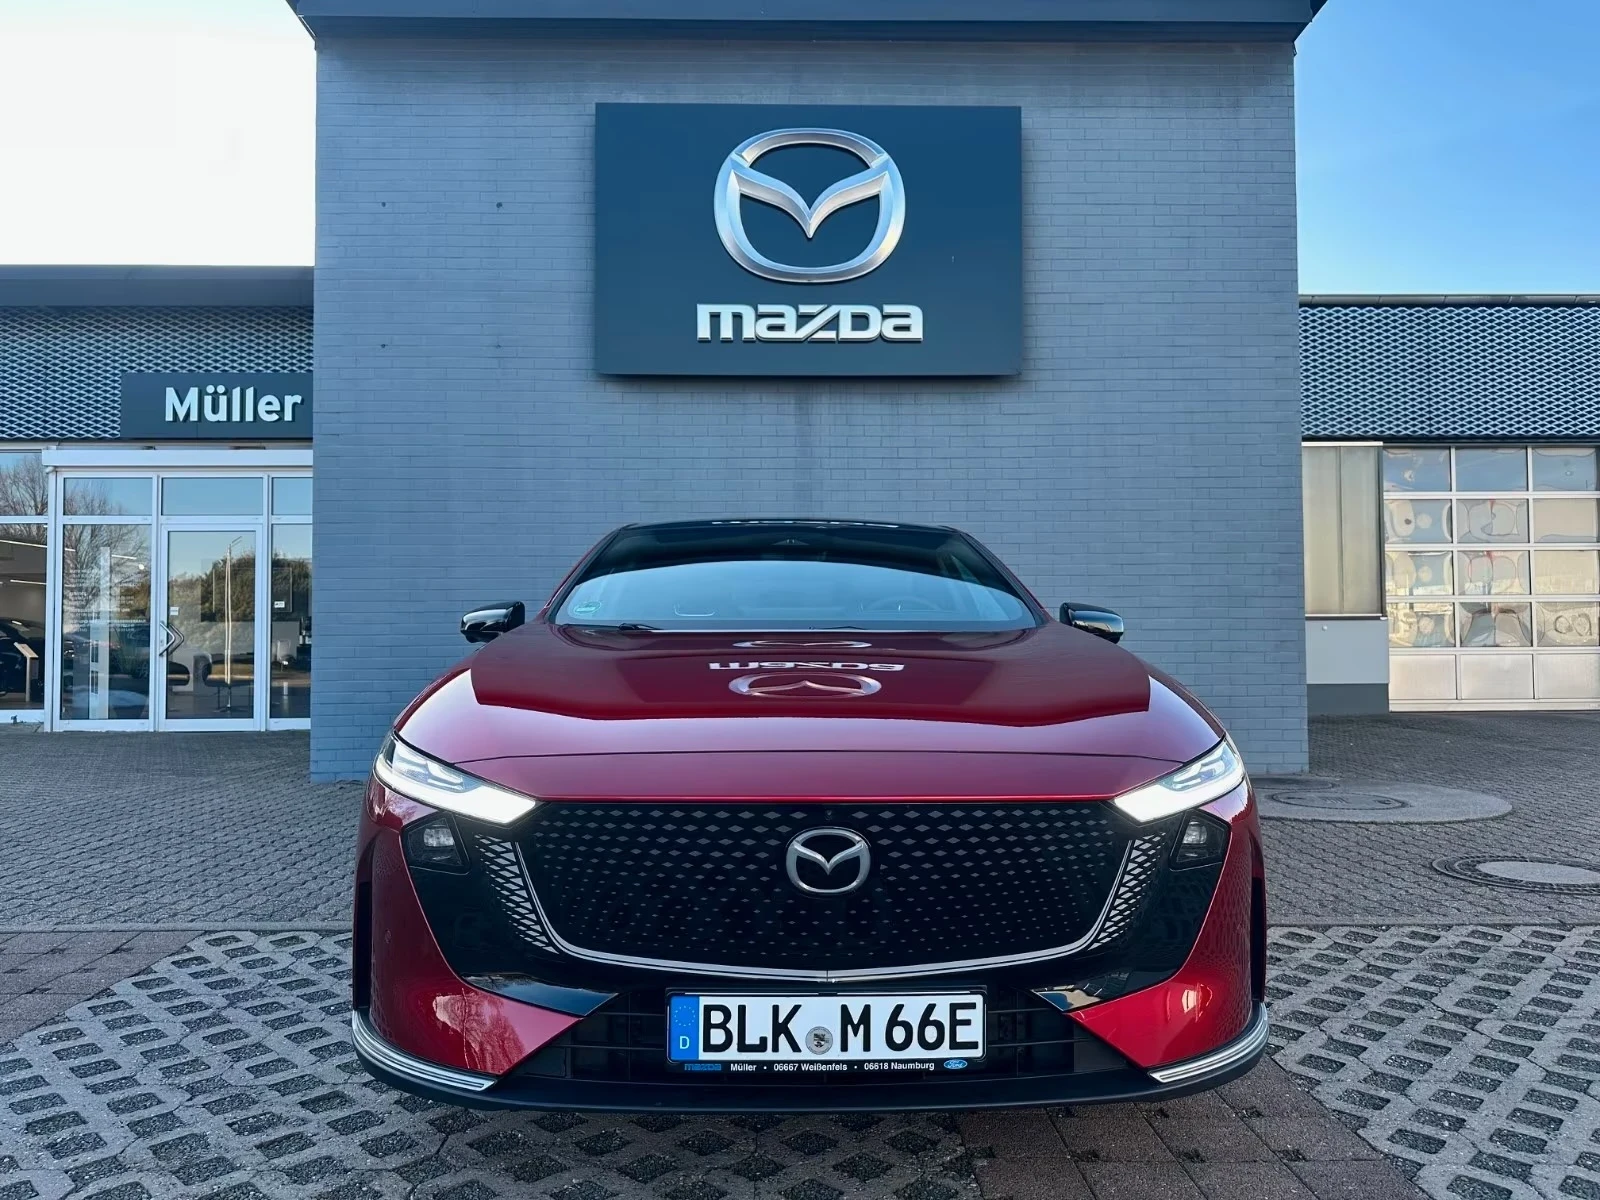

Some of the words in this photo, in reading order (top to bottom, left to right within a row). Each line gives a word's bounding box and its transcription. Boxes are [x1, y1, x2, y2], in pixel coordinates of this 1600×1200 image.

[697, 304, 923, 342] mazda
[165, 385, 302, 422] Müller
[702, 1004, 802, 1053] BLK
[840, 1004, 871, 1053] M
[885, 1002, 979, 1051] 66E
[679, 1036, 690, 1049] D
[730, 1063, 757, 1071] Müller
[773, 1063, 799, 1071] 06667
[800, 1062, 848, 1071] Weißenfels
[863, 1062, 889, 1070] 06618
[890, 1061, 935, 1071] Naumburg
[946, 1060, 966, 1069] Ford
